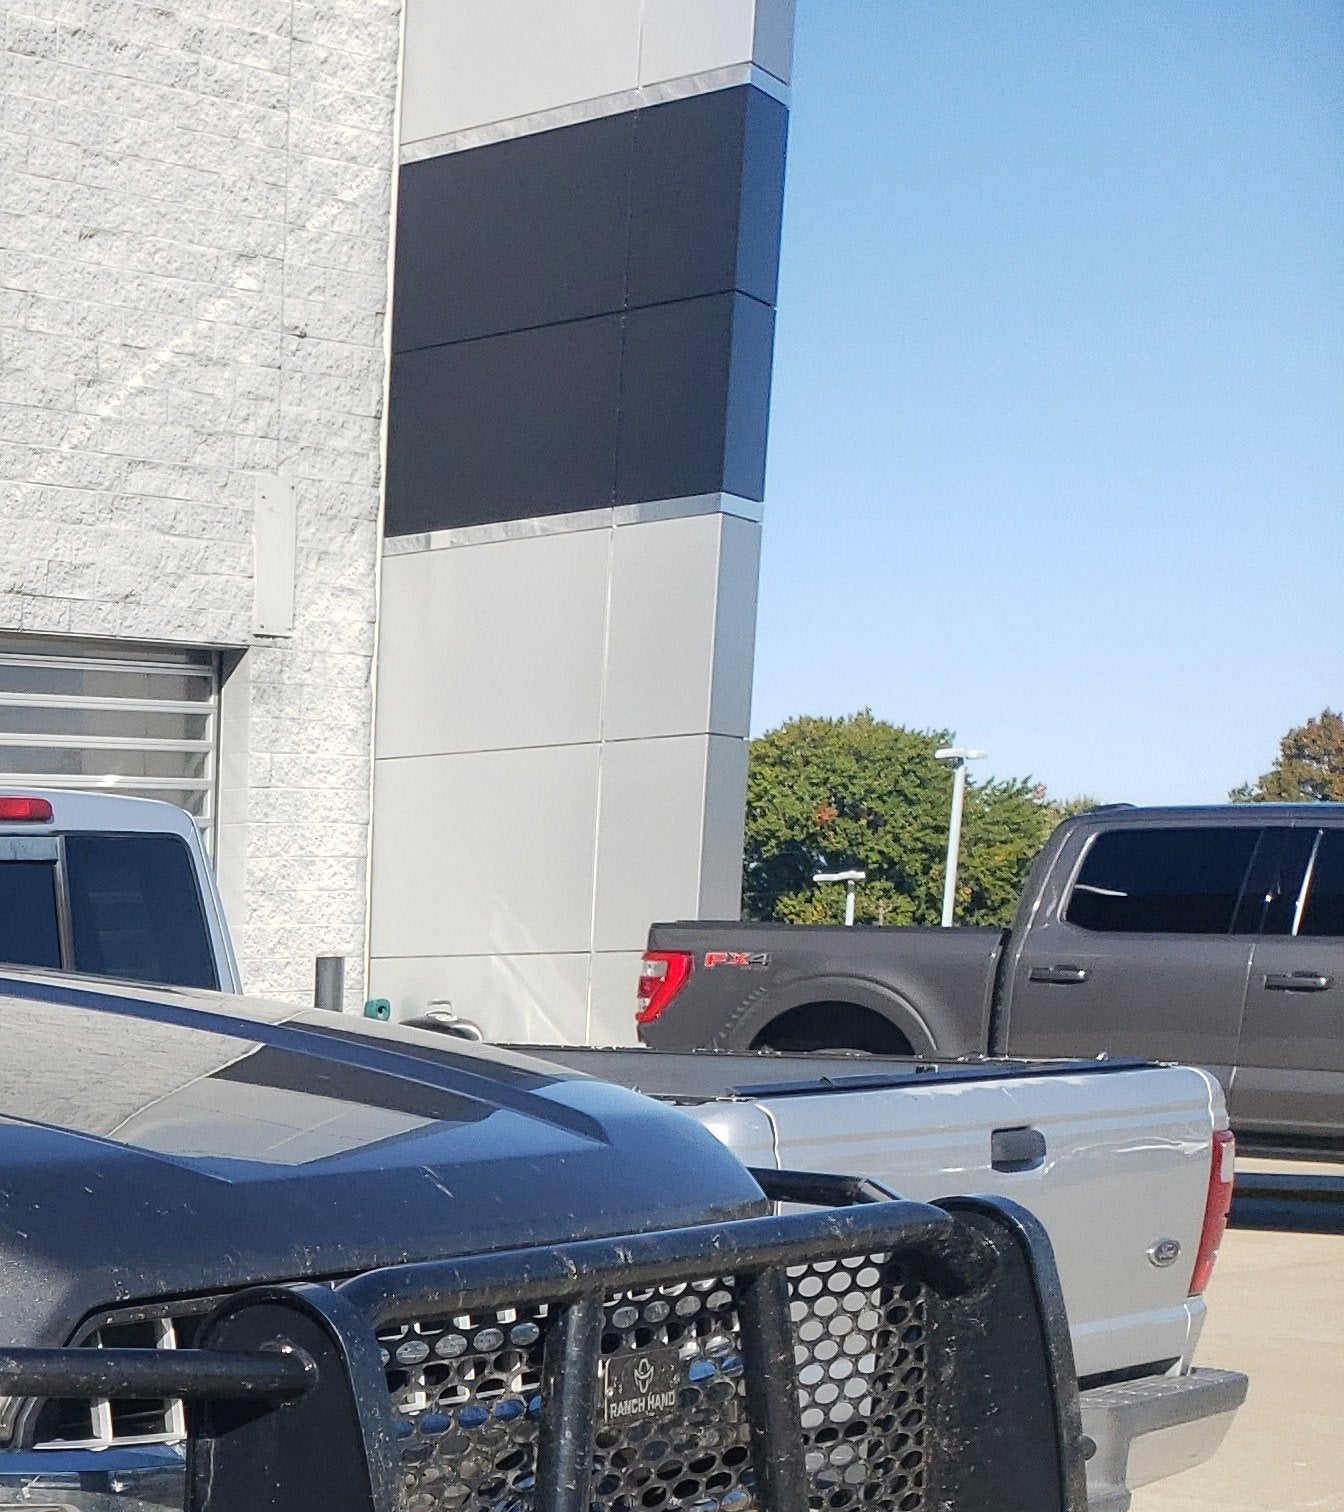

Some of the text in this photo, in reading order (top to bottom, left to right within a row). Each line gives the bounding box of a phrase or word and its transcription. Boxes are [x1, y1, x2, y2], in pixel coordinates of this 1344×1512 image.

[704, 952, 769, 967] FX4
[609, 1391, 676, 1419] RANCH HAND
